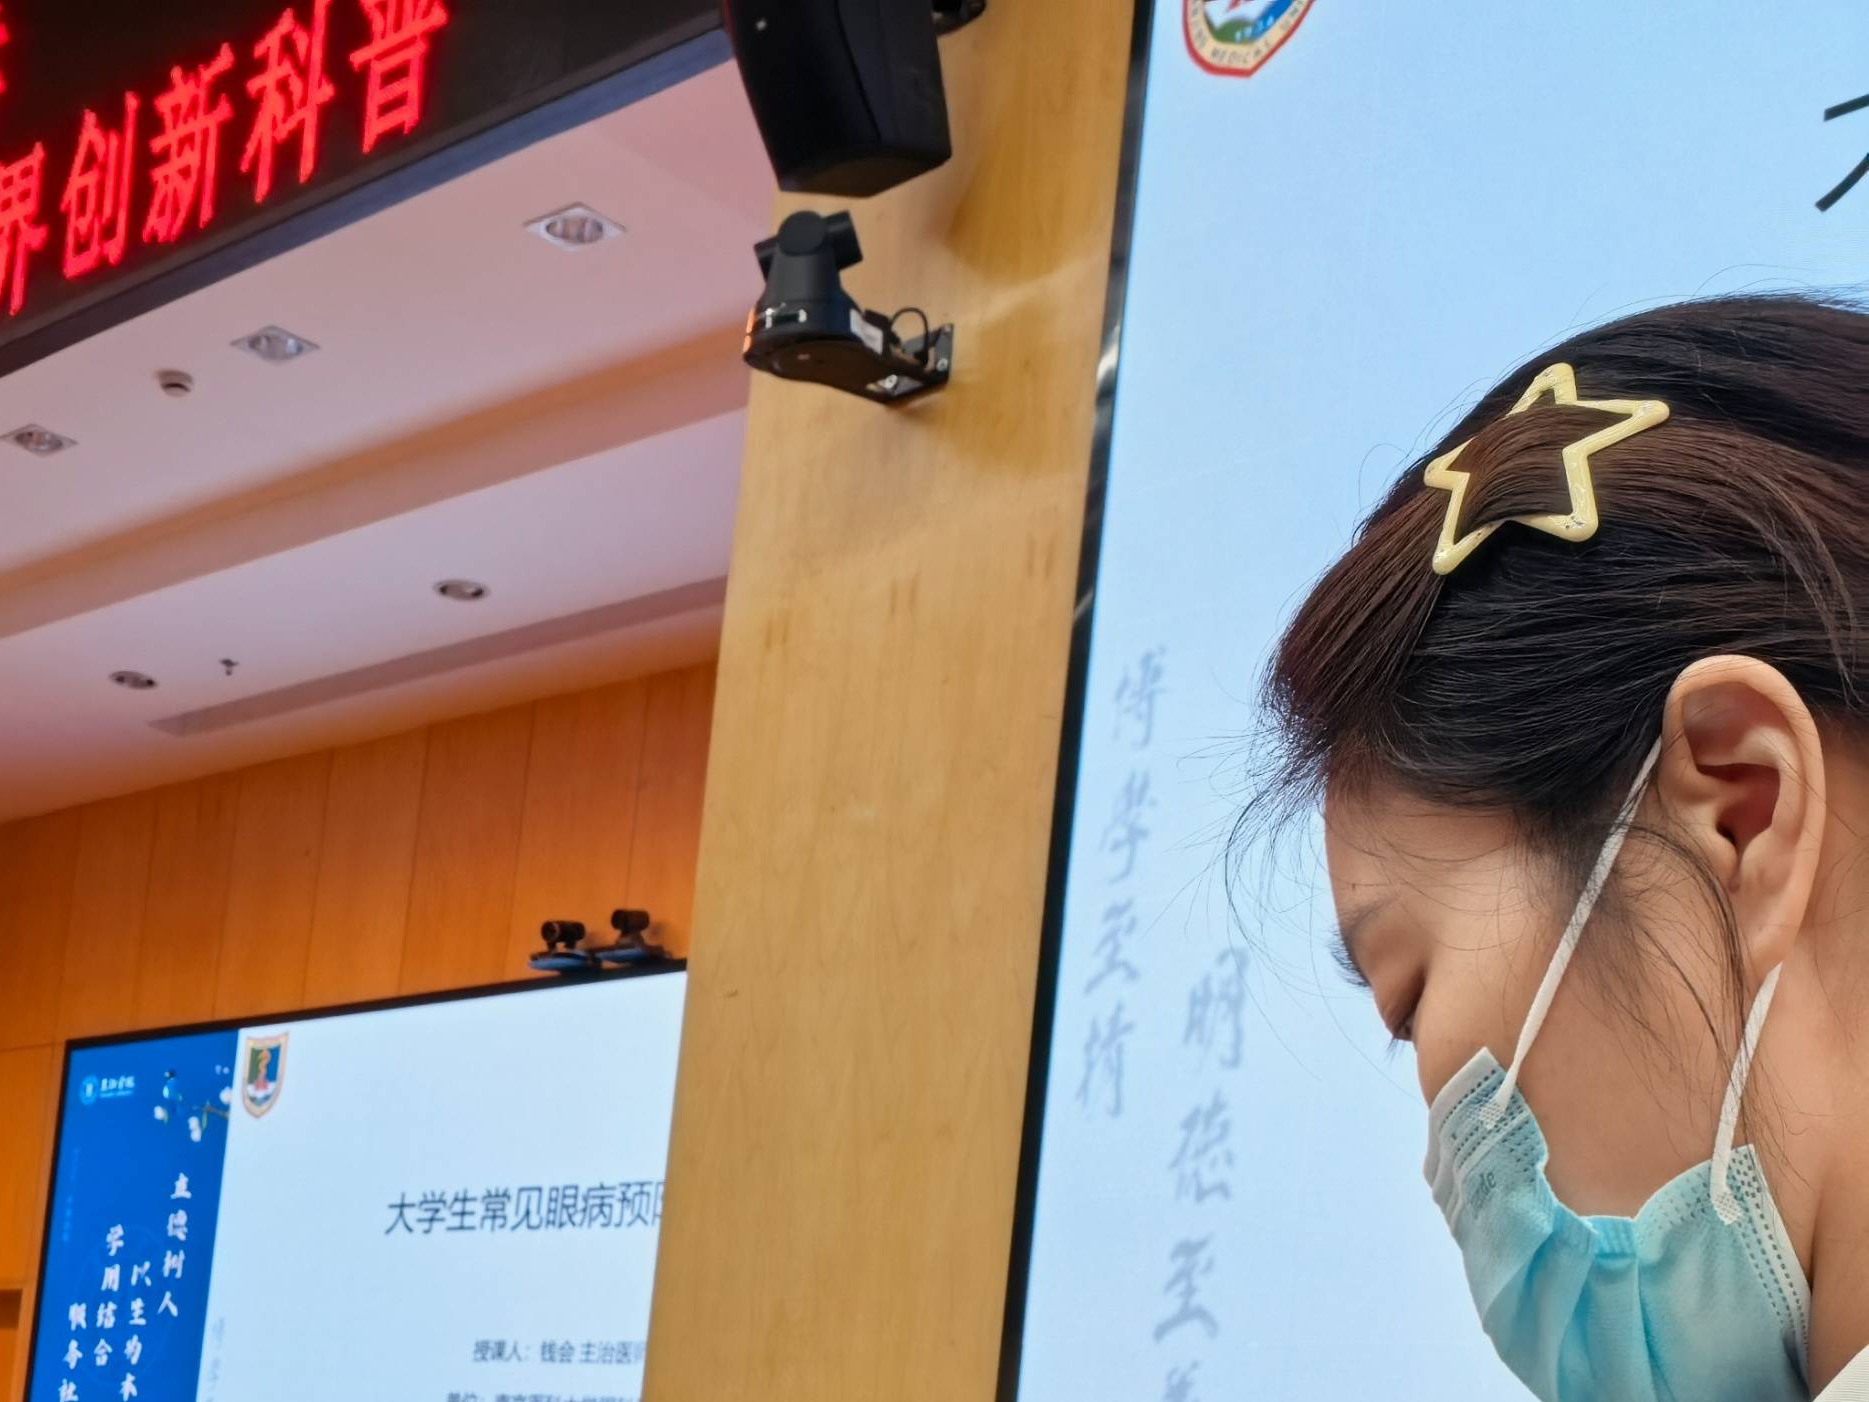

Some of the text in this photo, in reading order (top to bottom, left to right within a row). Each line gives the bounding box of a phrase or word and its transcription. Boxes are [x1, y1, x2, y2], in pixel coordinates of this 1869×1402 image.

[93, 1224, 125, 1367] 学用结合
[157, 1172, 193, 1318] 立德树人
